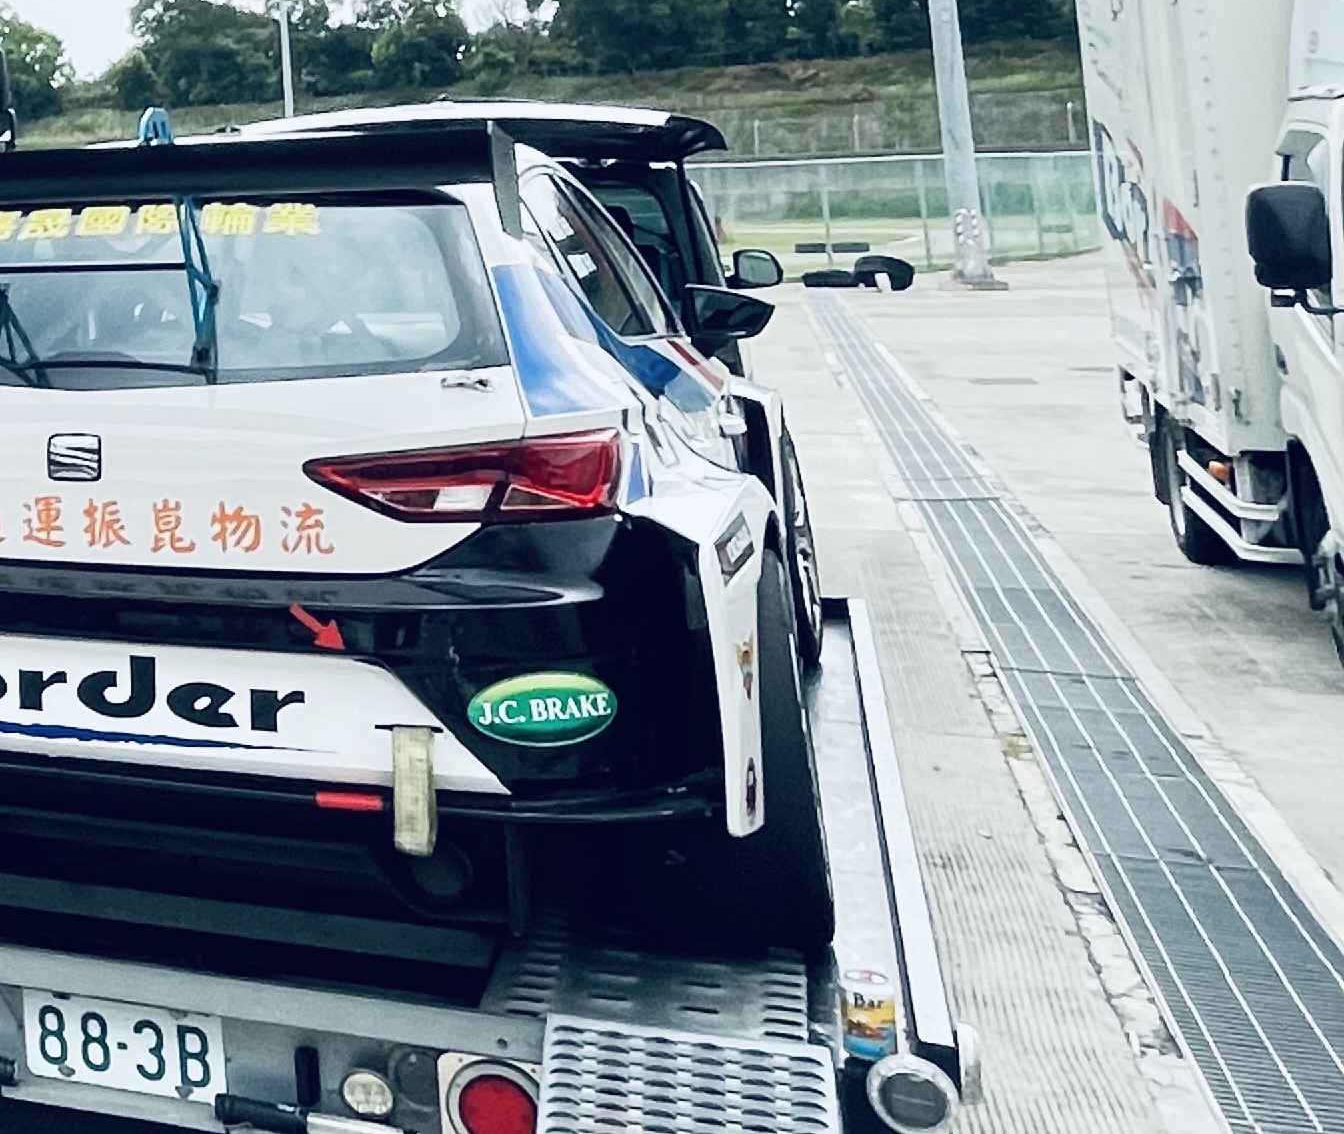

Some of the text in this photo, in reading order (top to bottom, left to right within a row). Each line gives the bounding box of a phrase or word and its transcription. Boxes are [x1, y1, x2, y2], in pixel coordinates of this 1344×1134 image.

[478, 692, 612, 726] J.C. BRAKE
[38, 1004, 212, 1088] 88-3B
